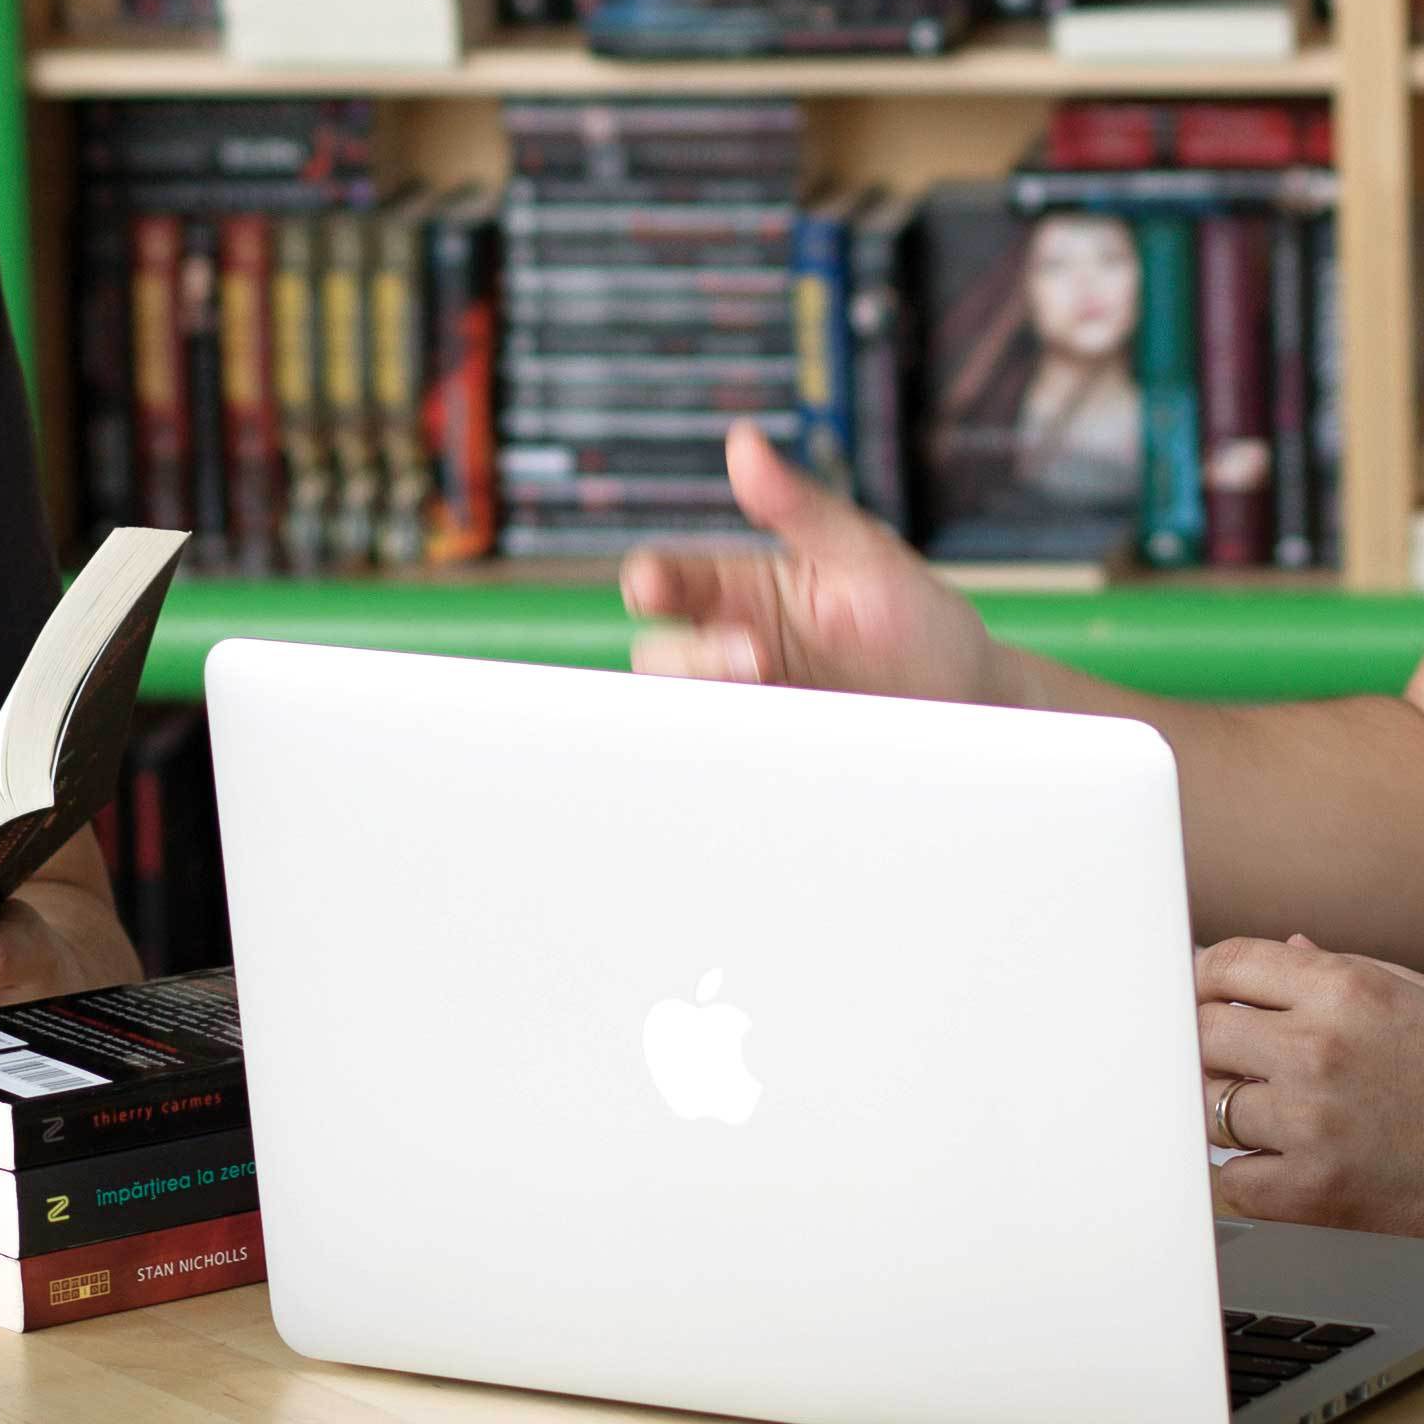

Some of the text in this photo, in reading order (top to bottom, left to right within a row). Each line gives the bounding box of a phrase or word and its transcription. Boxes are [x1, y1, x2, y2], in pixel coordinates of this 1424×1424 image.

[92, 1092, 224, 1128] thierry carmes
[197, 1169, 215, 1185] la
[137, 1246, 248, 1283] STAN NICHOLLS
